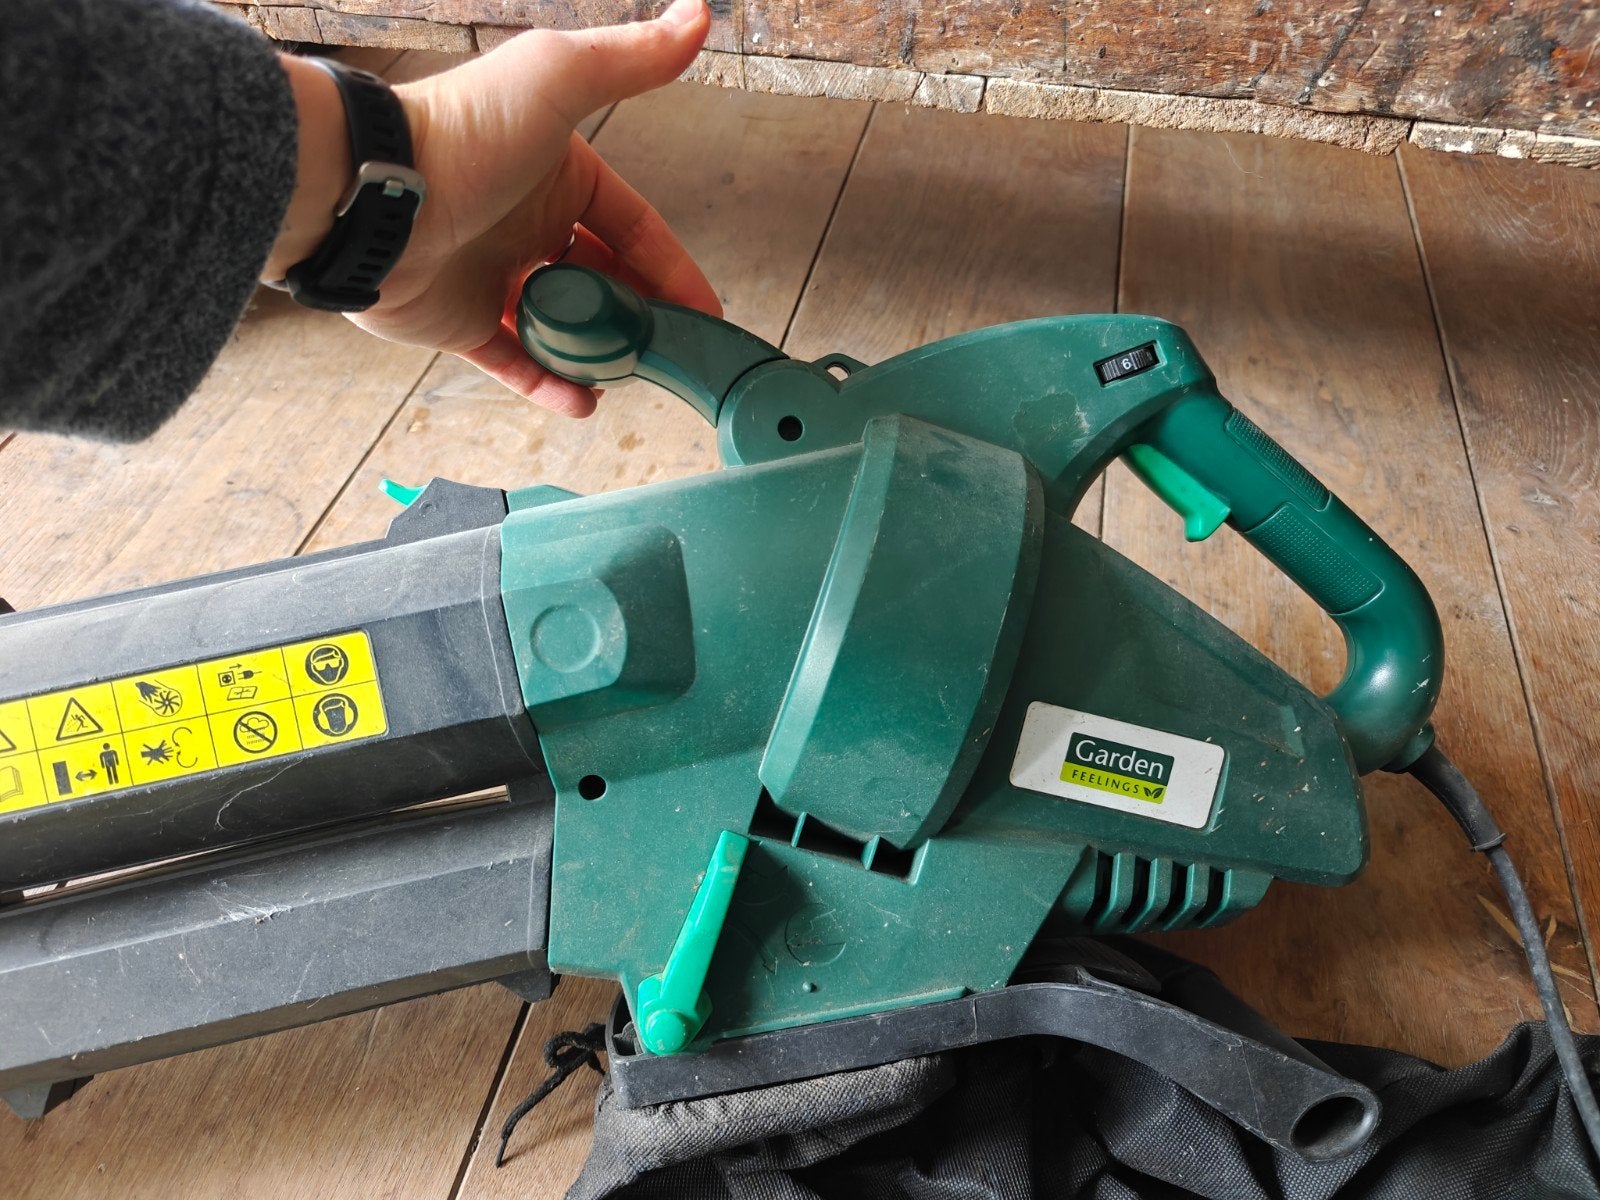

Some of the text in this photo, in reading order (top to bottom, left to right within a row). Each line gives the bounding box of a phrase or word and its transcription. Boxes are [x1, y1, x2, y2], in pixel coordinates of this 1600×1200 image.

[1122, 358, 1132, 370] 6
[1075, 740, 1163, 779] Garden
[1072, 769, 1139, 793] FEELINGS
